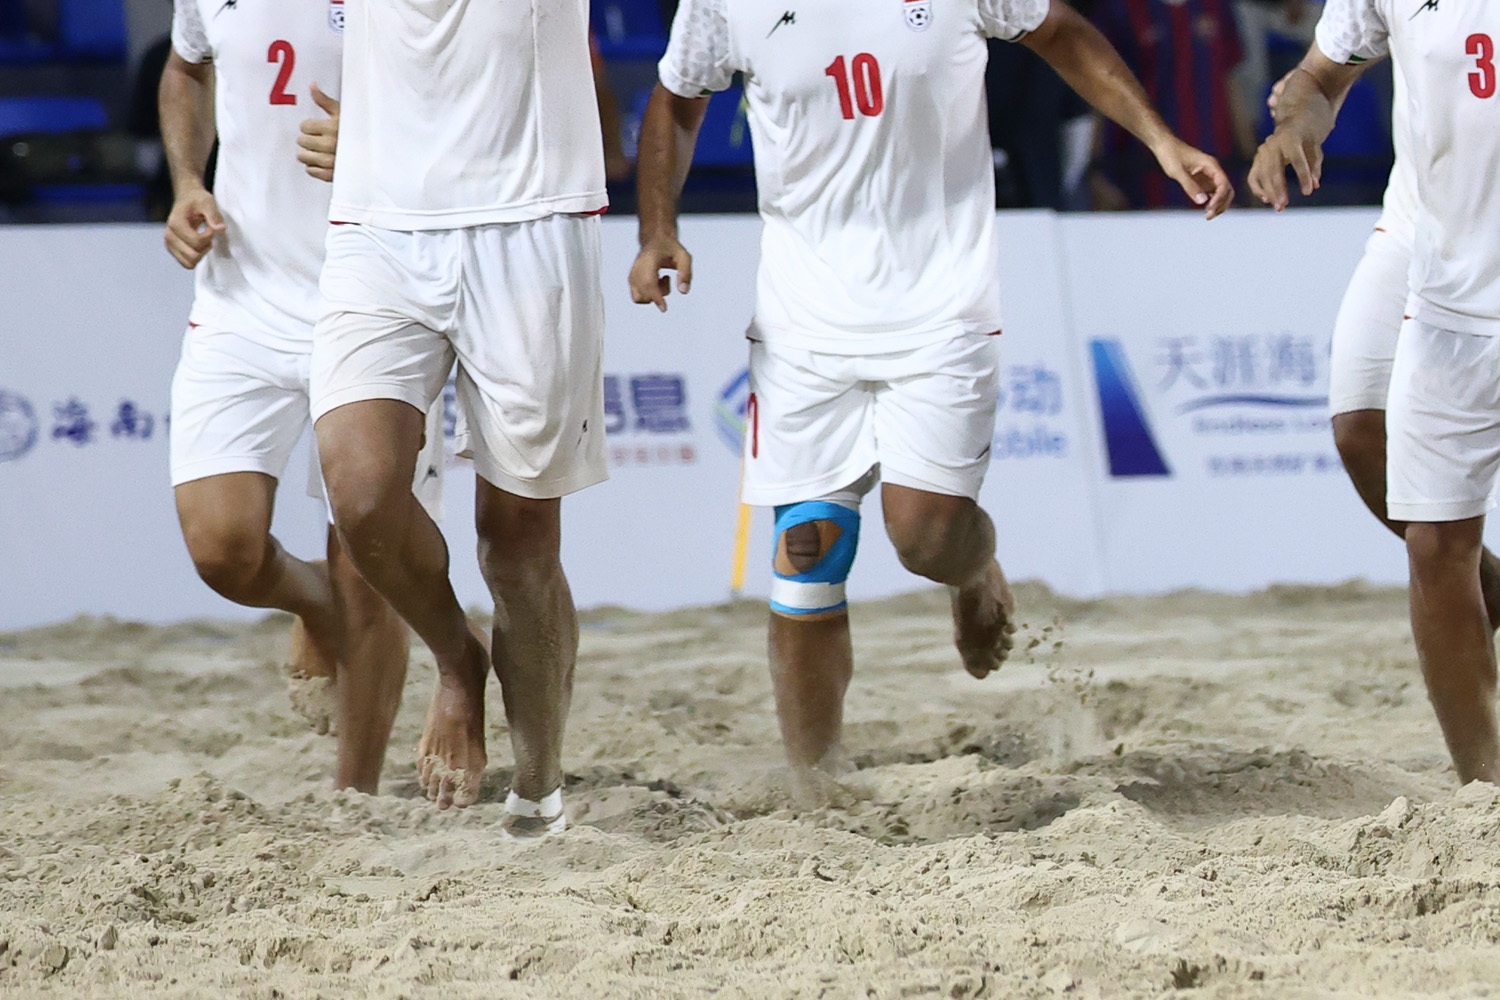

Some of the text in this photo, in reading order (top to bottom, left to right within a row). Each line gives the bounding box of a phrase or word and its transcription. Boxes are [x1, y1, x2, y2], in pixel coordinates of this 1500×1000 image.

[267, 40, 297, 105] 2
[825, 52, 884, 120] 10
[1465, 33, 1496, 99] 3
[52, 398, 169, 446] 海南
[1000, 365, 1063, 416] 动
